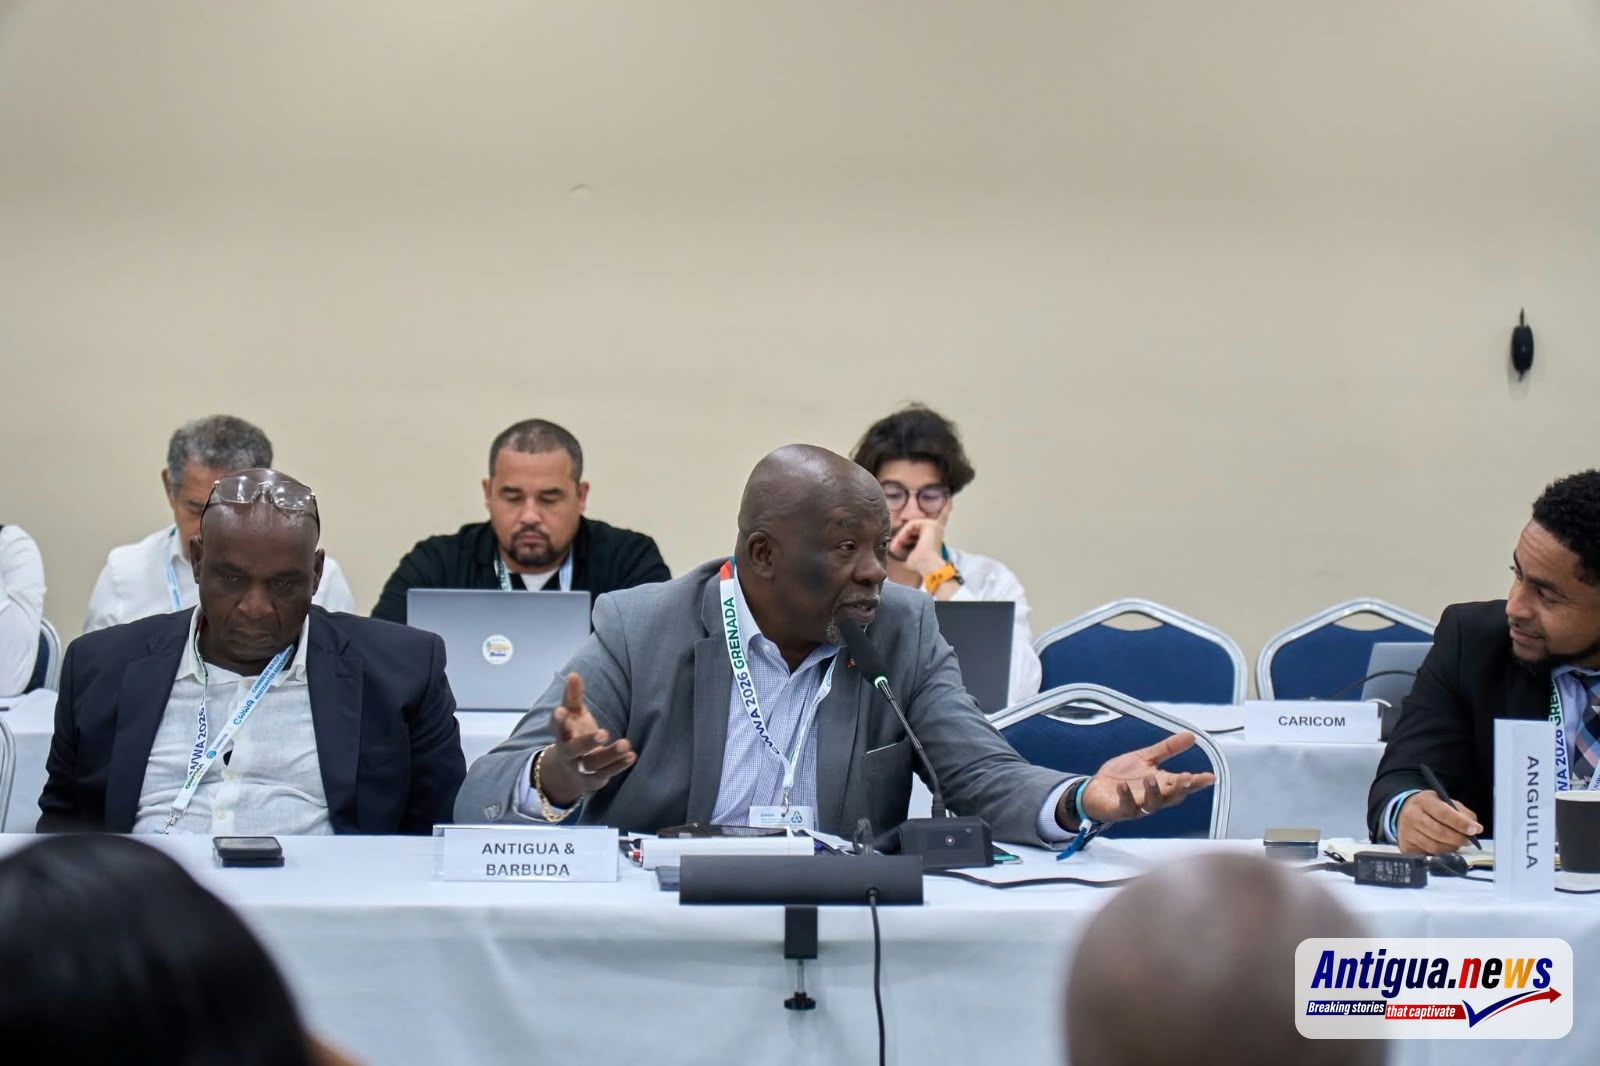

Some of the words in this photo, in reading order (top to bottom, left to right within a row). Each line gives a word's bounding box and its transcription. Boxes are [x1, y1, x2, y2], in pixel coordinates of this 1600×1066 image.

[723, 597, 745, 670] GRENADA
[737, 671, 756, 708] 2026
[232, 699, 255, 726] CWWA
[1278, 715, 1346, 727] CARICOM
[1555, 729, 1567, 766] 2026
[1526, 755, 1540, 870] ANGUILLA
[482, 842, 559, 855] ANTIGUA
[564, 842, 575, 855] &
[486, 863, 570, 876] BARBUDA
